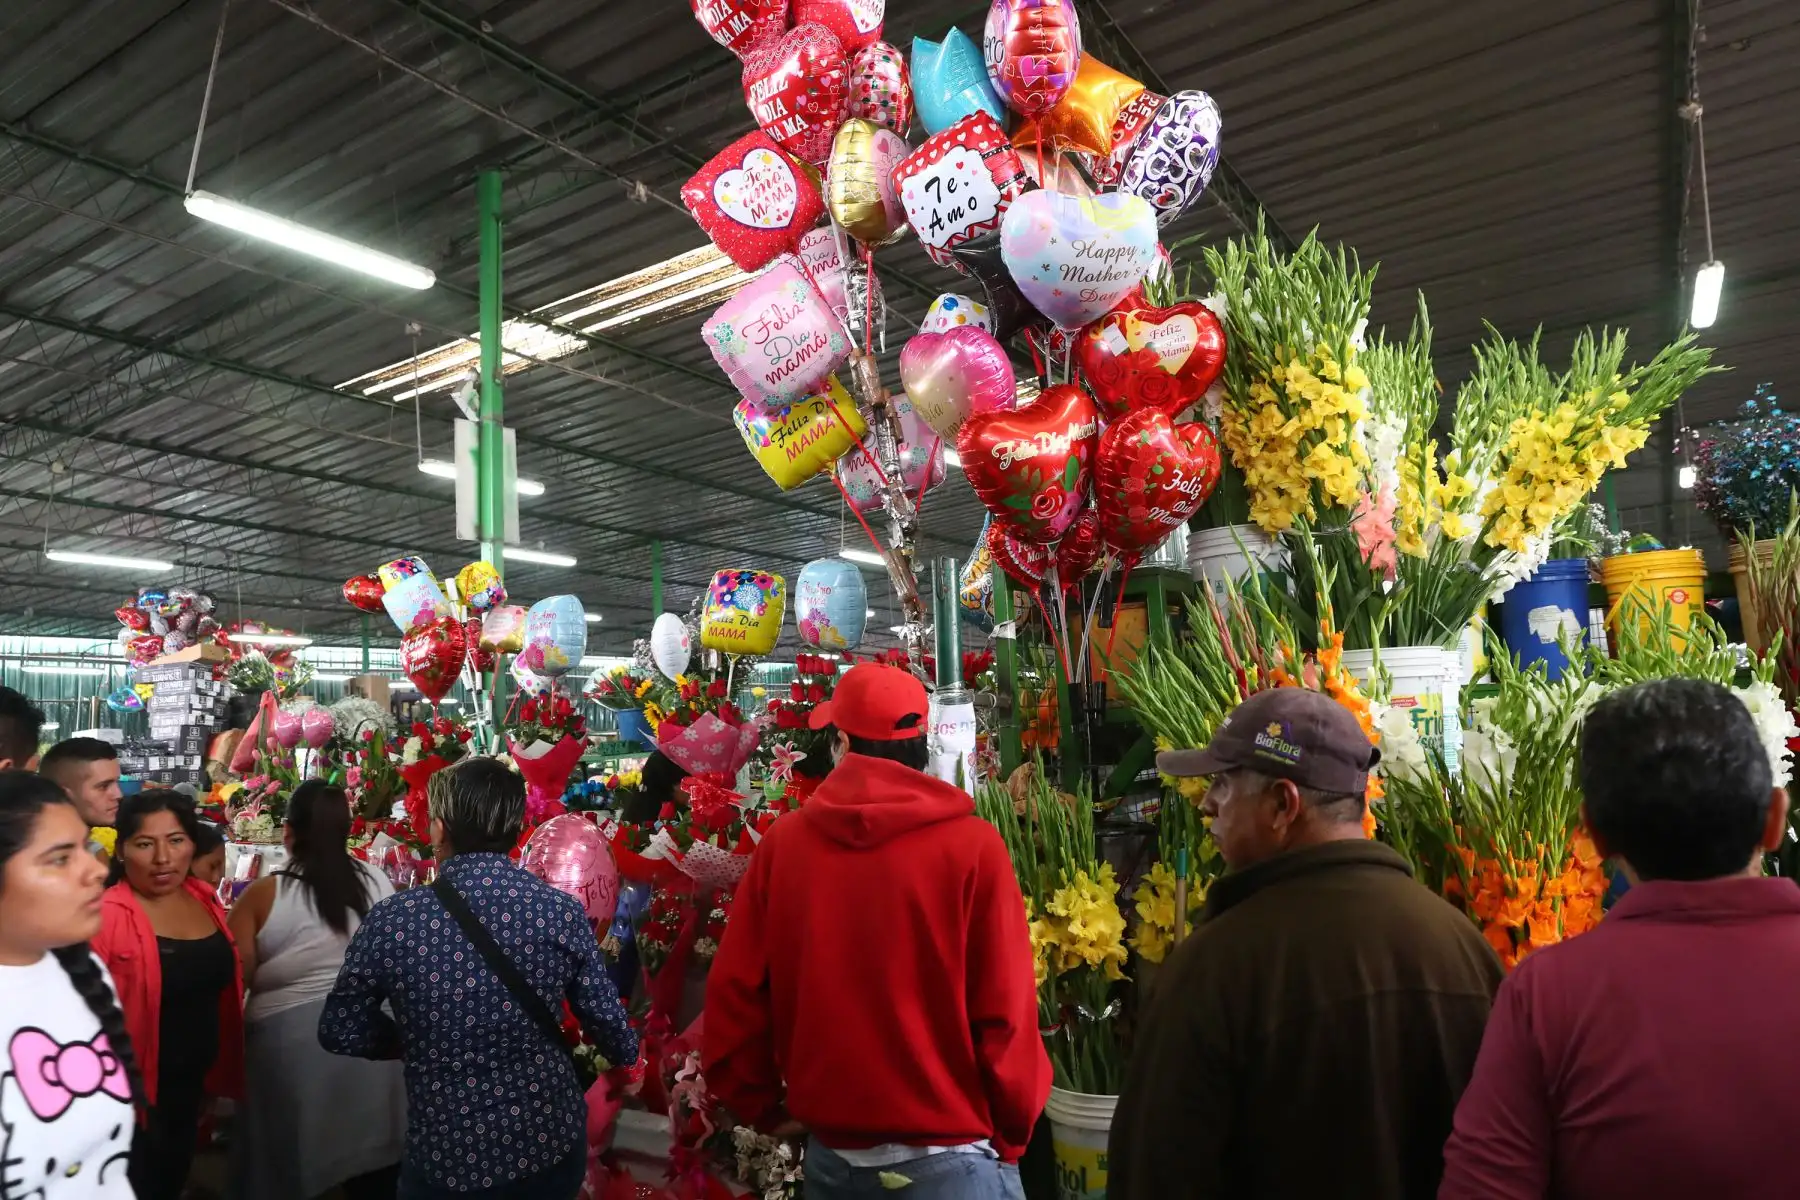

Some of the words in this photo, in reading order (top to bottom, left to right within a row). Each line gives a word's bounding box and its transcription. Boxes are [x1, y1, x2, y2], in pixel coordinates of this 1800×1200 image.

[925, 176, 957, 203] Te
[929, 196, 977, 238] Amo
[801, 235, 831, 250] eliz
[1072, 239, 1137, 265] Happy
[803, 252, 840, 281] amá
[1060, 261, 1141, 283] Mother's
[1080, 286, 1119, 303] Day
[742, 303, 805, 345] Feliz
[1149, 323, 1182, 340] Feliz
[771, 415, 810, 449] Feliz
[1163, 469, 1202, 500] Feliz
[1255, 732, 1302, 757] BioFlora
